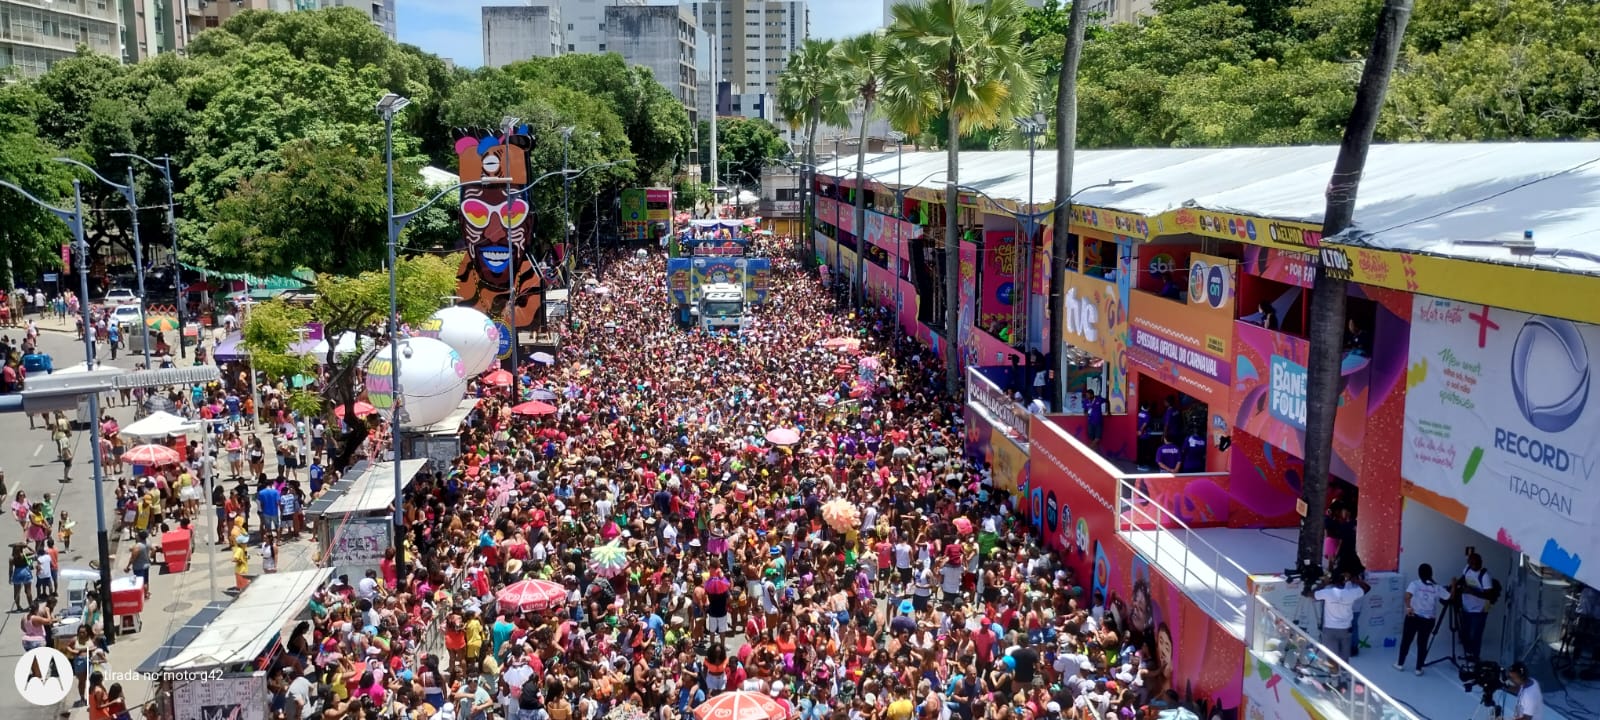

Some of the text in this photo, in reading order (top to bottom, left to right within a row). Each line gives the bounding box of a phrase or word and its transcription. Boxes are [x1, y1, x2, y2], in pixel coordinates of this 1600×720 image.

[1150, 258, 1176, 274] sbt
[1065, 287, 1098, 342] tve
[1136, 330, 1218, 377] EMISSORA OFICIAL DO CARNAVAL
[1272, 390, 1307, 426] FOLIA
[1509, 475, 1573, 516] ITAPOAN
[1076, 524, 1089, 556] sbt
